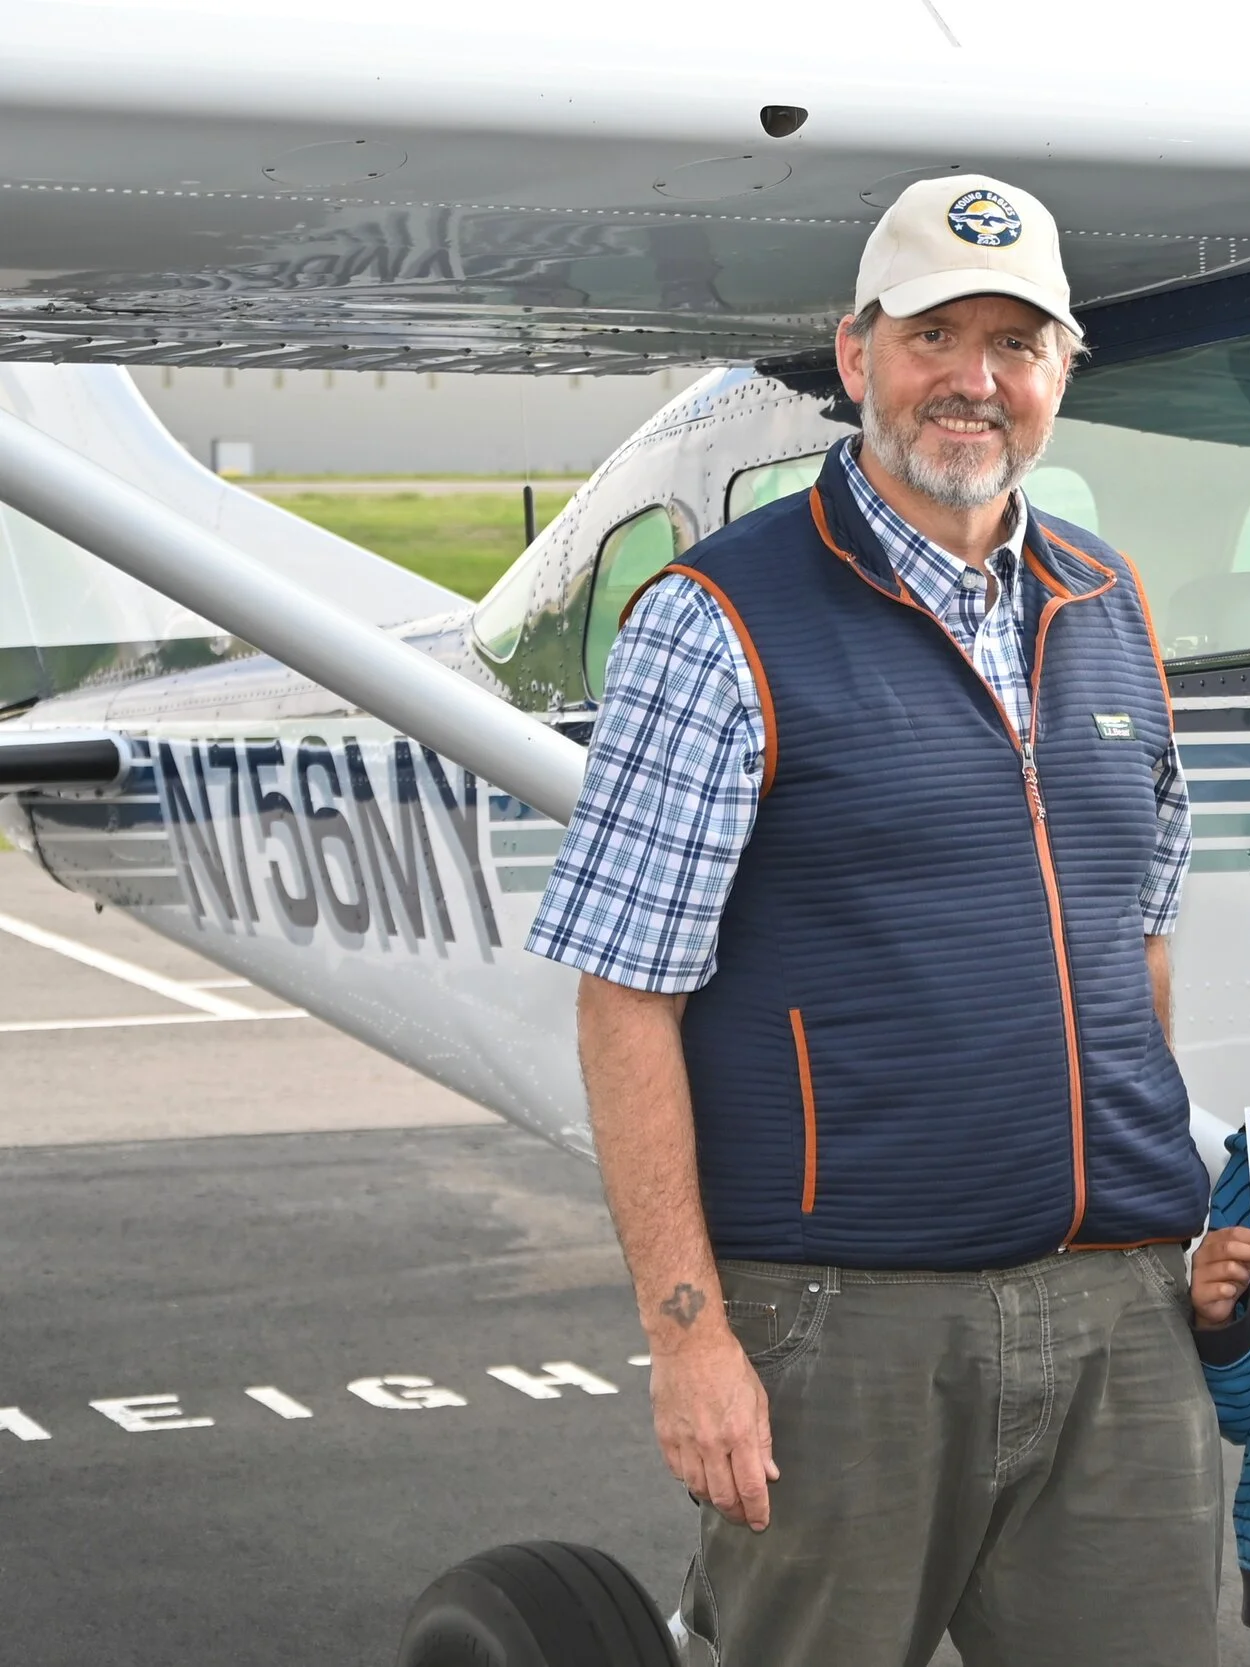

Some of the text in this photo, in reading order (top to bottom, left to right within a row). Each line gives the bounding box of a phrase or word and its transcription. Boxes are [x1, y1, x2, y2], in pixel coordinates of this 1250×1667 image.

[954, 192, 1016, 217] YOUNG EAGLES
[155, 736, 502, 950] N756MY
[0, 1355, 651, 1441] EIGH
